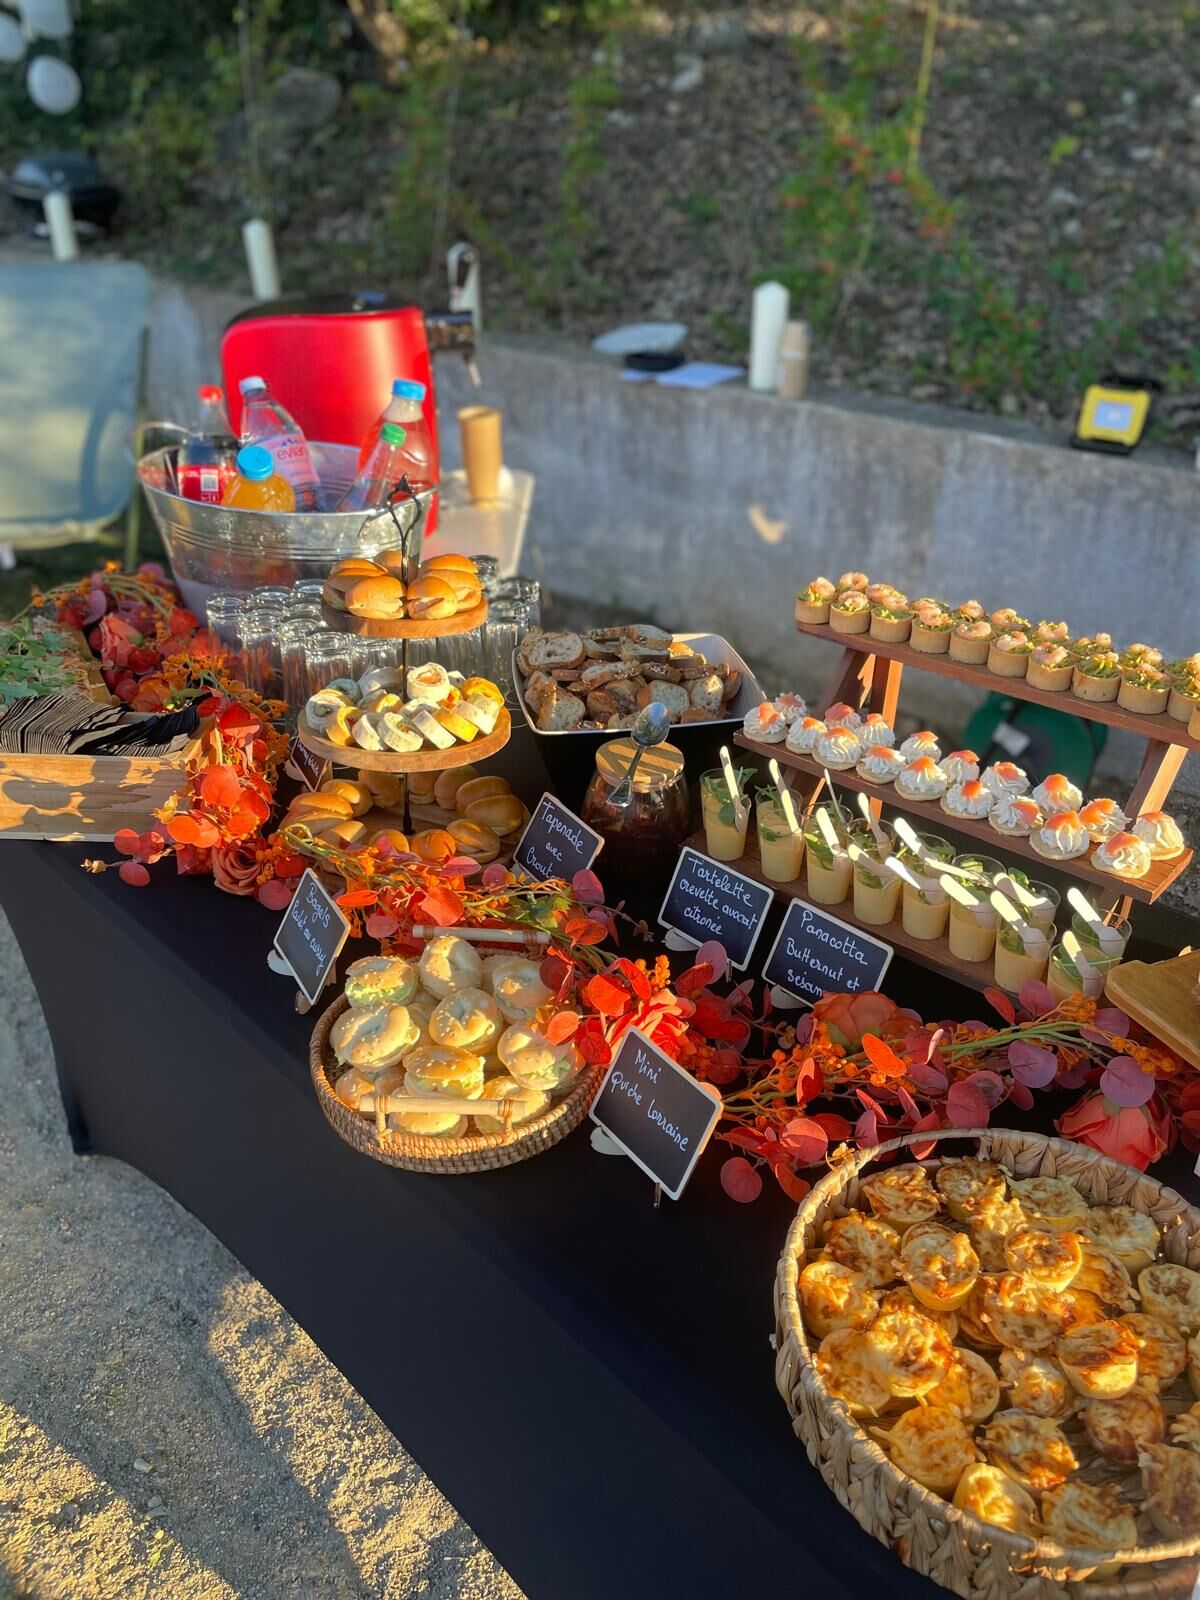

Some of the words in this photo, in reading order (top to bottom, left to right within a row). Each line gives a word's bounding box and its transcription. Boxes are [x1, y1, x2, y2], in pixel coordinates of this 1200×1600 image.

[541, 801, 583, 854] Tapenade
[527, 846, 561, 879] Crout
[546, 842, 562, 862] avec
[688, 857, 753, 907] Tartelette
[306, 882, 331, 928] Bagels
[722, 904, 758, 930] avocat
[303, 928, 311, 941] au
[800, 910, 868, 966] Panacotta
[786, 937, 844, 981] Butternut
[846, 976, 861, 991] et
[634, 1048, 662, 1084] Mini
[611, 1071, 642, 1106] Quiche
